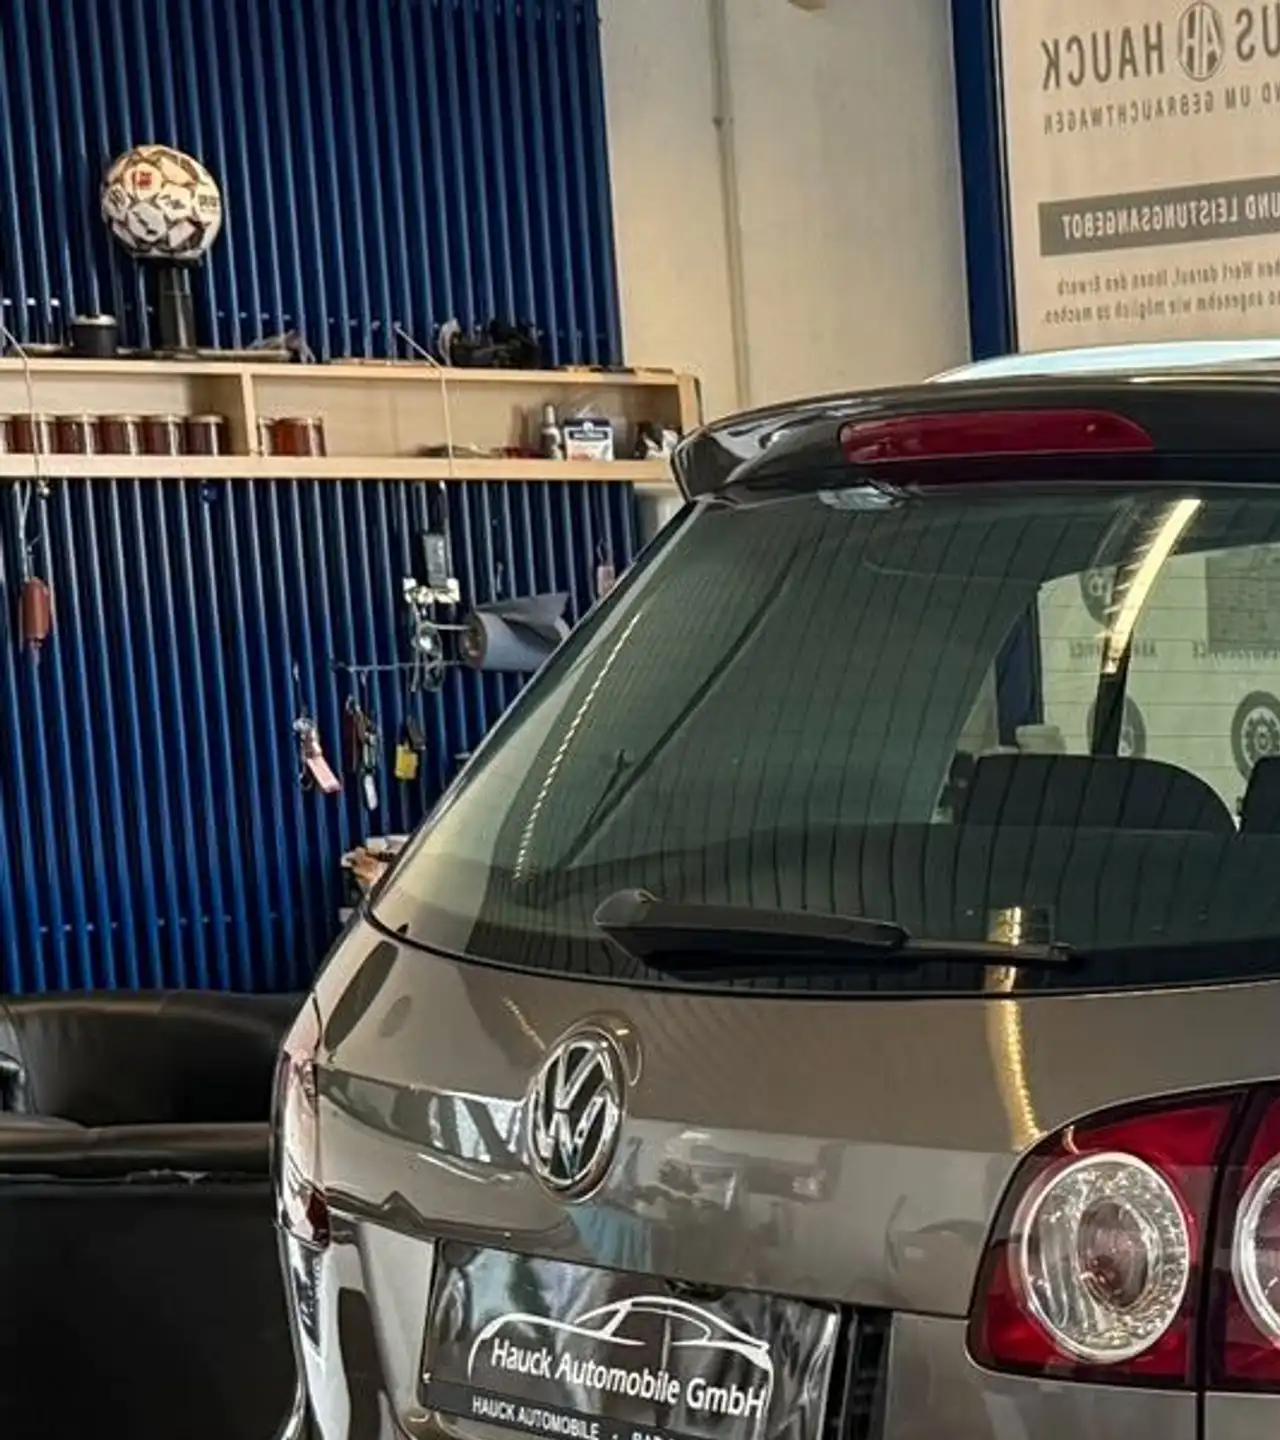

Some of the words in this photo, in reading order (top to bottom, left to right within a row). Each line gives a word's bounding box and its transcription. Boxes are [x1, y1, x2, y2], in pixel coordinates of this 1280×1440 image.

[490, 1336, 552, 1379] Hauck
[554, 1350, 681, 1403] Automobile
[685, 1376, 767, 1420] GmbH
[472, 1395, 515, 1423] HAUCK
